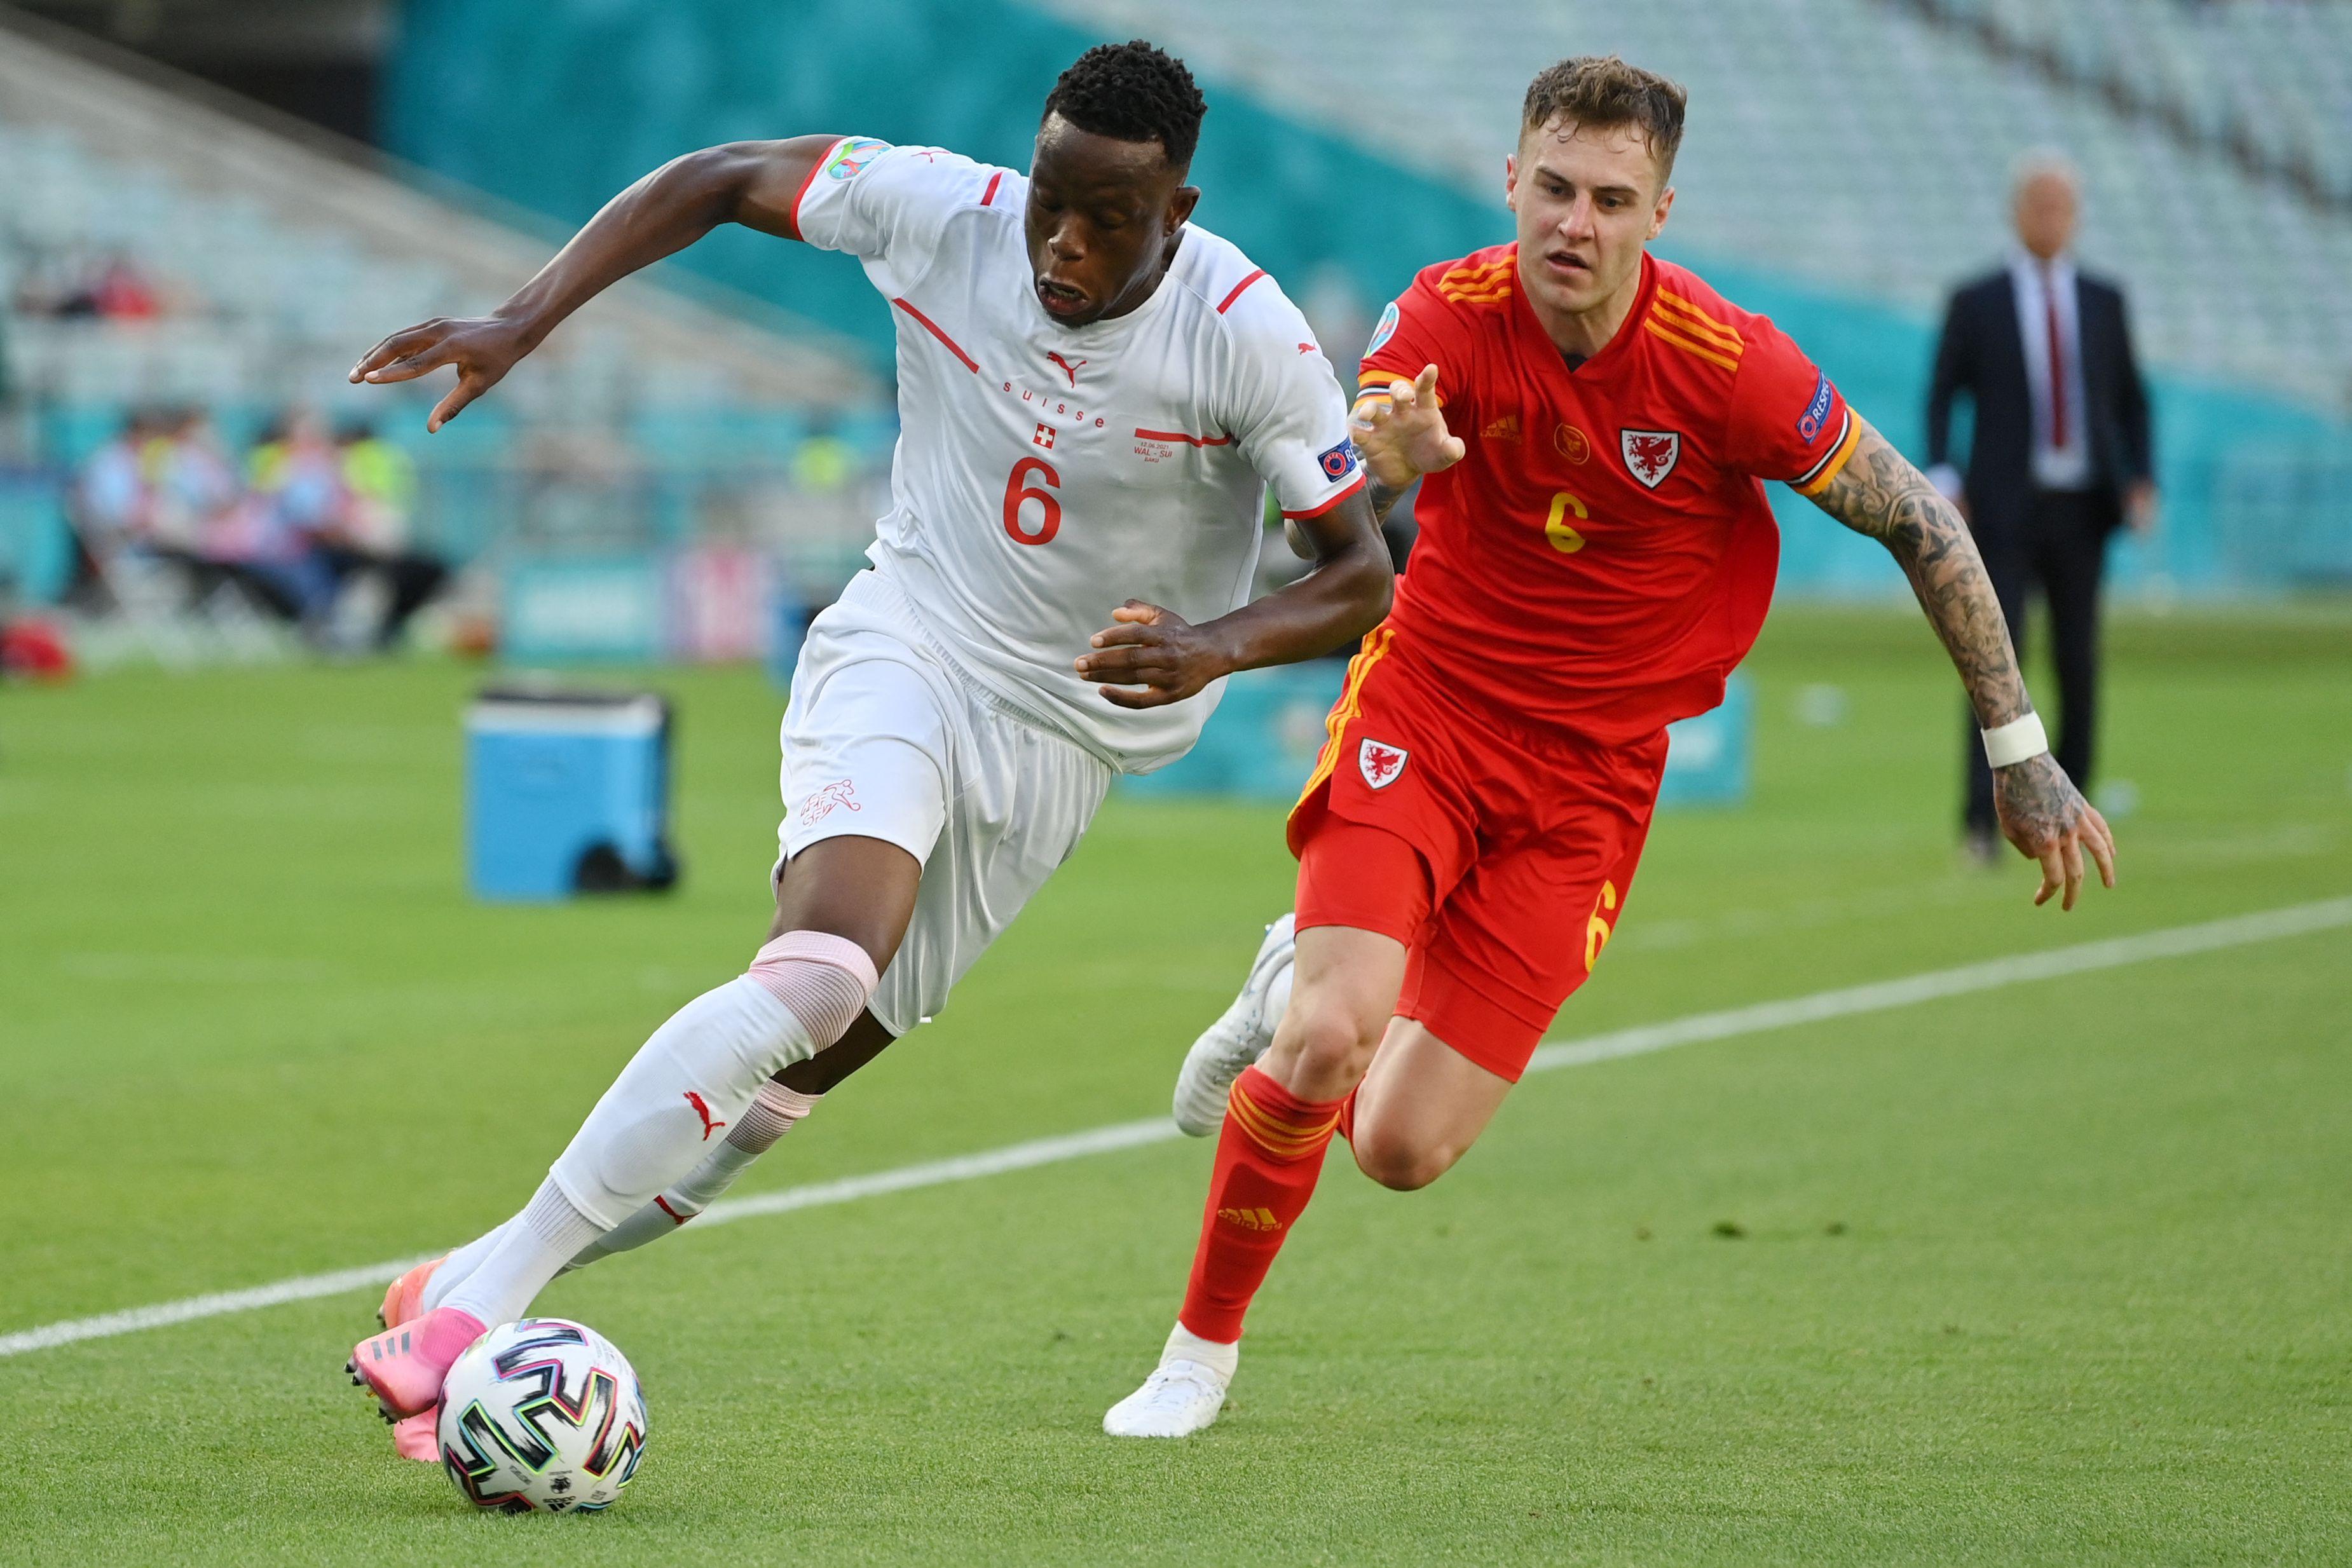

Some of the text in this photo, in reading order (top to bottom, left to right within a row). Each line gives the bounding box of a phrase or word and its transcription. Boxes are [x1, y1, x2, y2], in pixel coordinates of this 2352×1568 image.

[1003, 382, 1104, 428] suisse
[1134, 446, 1151, 456] WAL
[1003, 457, 1061, 545] 6
[1544, 491, 1589, 554] 6
[1585, 880, 1617, 973] 6
